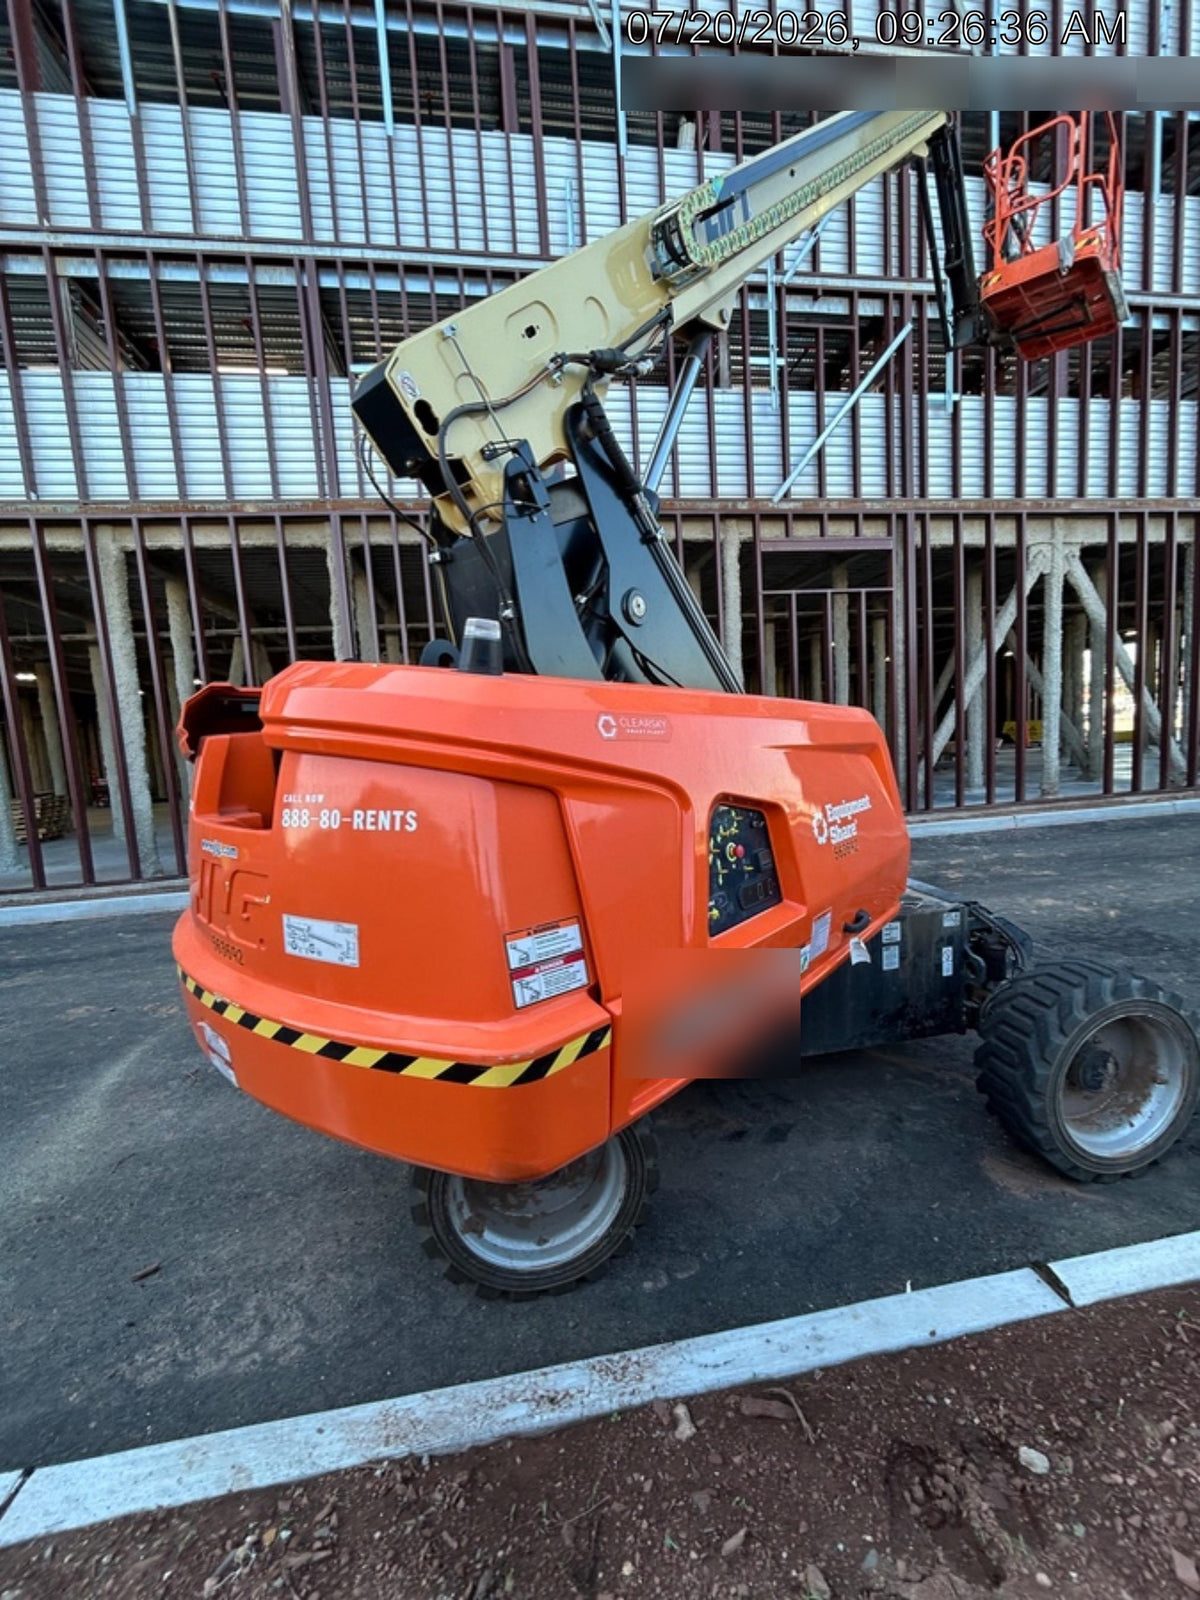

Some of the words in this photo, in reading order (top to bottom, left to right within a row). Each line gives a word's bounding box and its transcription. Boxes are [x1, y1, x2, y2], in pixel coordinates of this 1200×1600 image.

[281, 808, 418, 832] 888-80-RENTS
[825, 794, 872, 823] Equipment
[829, 821, 858, 845] Share
